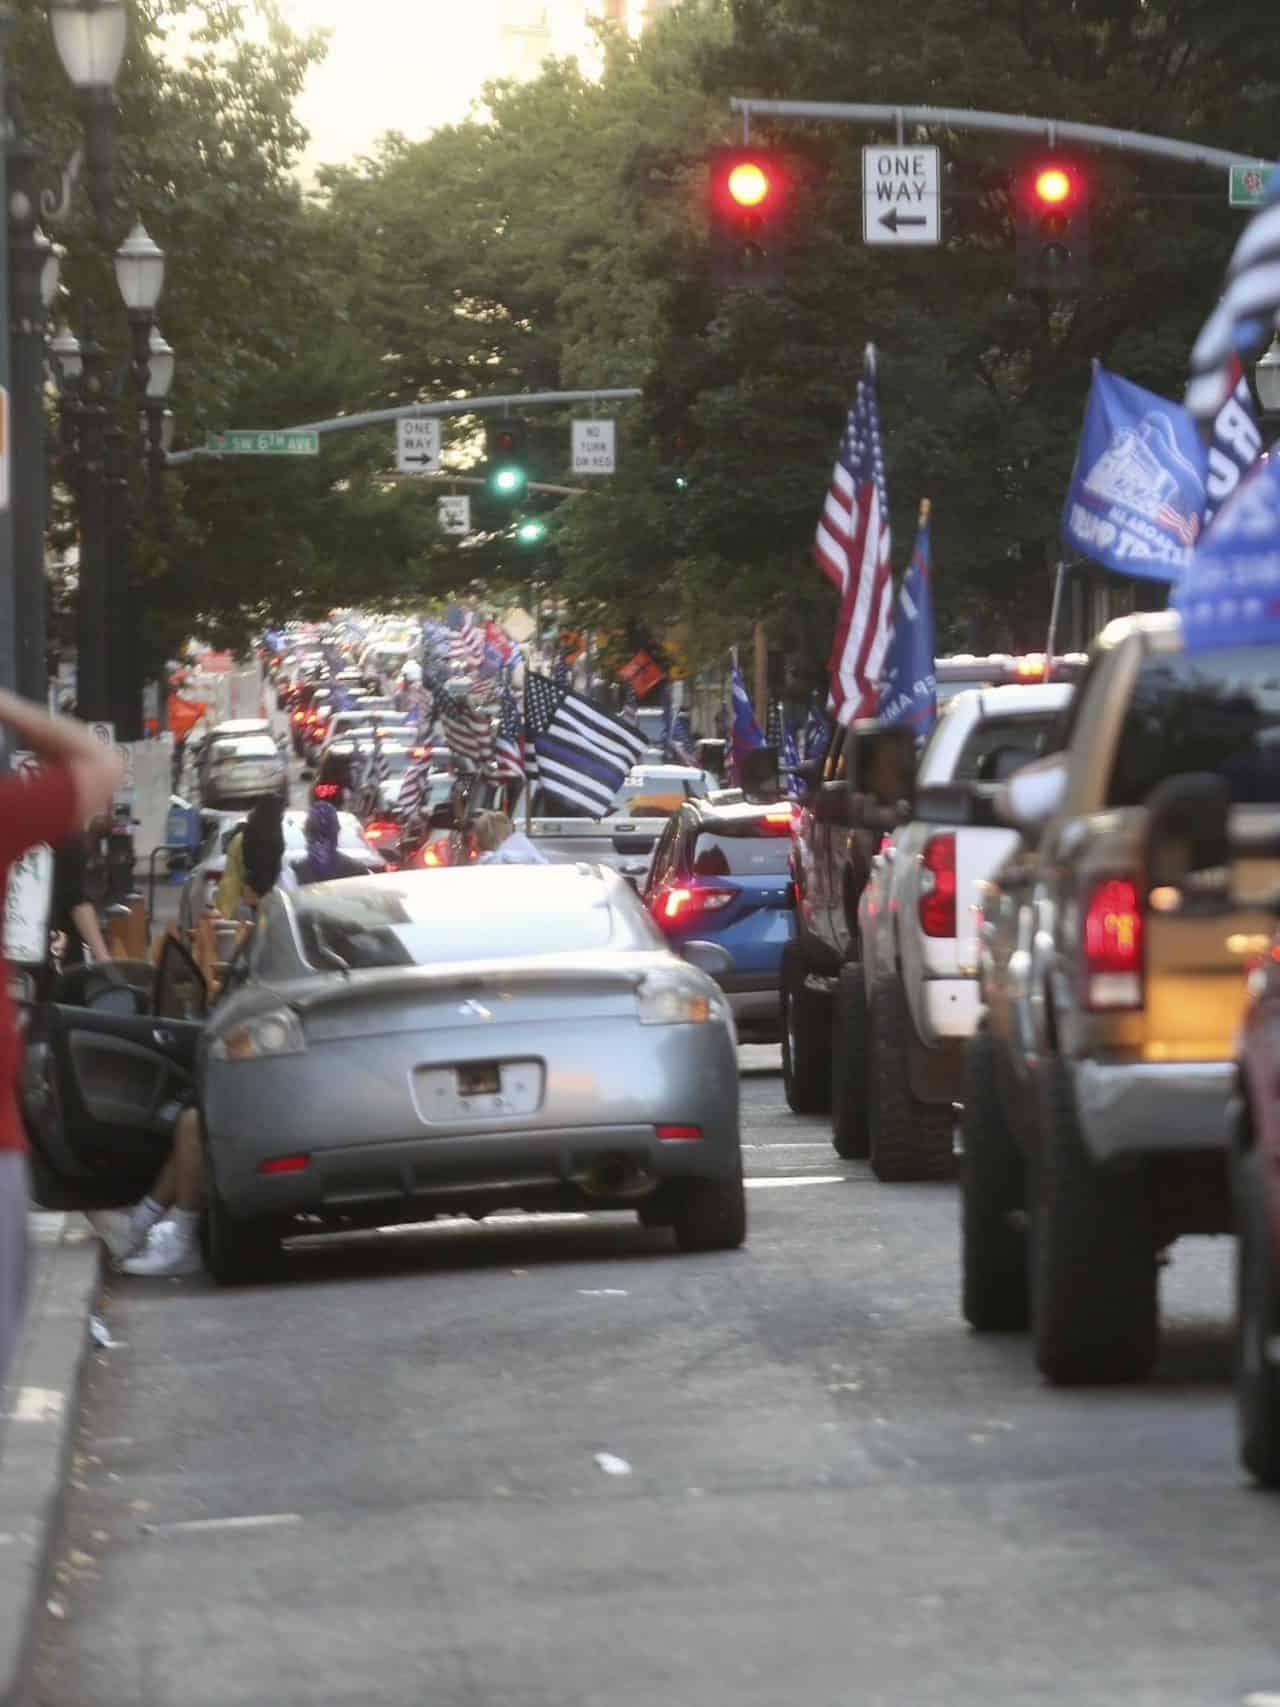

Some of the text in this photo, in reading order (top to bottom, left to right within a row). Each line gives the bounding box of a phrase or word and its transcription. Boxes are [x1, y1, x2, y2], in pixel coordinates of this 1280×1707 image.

[877, 155, 926, 176] ONE
[876, 180, 927, 201] WAY
[403, 422, 433, 434] ONE
[232, 436, 254, 449] SW
[287, 437, 313, 450] AVE
[404, 439, 432, 449] WAY
